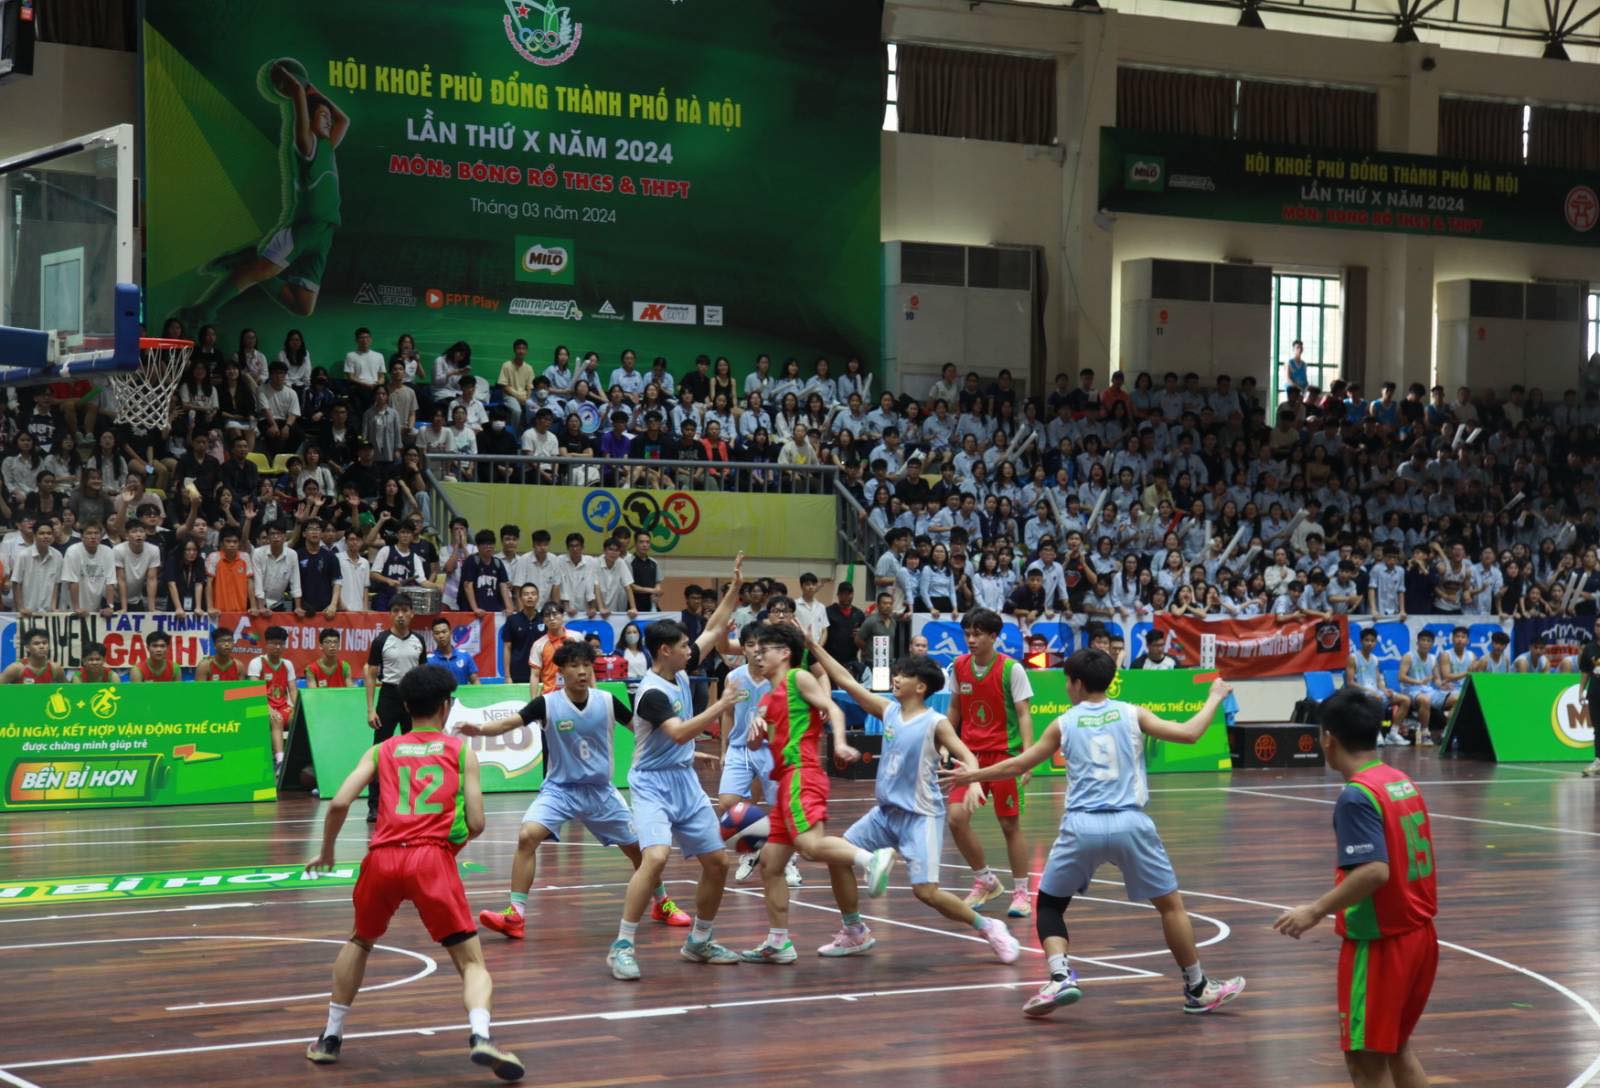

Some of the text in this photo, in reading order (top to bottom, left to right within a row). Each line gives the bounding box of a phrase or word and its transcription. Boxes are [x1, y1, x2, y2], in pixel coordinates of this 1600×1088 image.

[329, 57, 742, 133] HỘI KHOẺ PHÙ ĐỔNG THÀNH PHỐ HÀ NỘI
[407, 108, 674, 164] LẦN THỨ X NĂM 2024
[389, 153, 690, 199] MÔN: BÓNG RỔ THCS & THPT
[1245, 151, 1271, 177] HỘI
[1473, 171, 1492, 192] HÀ
[1495, 171, 1519, 196] NỘI
[470, 197, 616, 224] Tháng 03 năm 2024
[1371, 191, 1382, 206] X
[1387, 188, 1424, 209] NĂM
[1428, 197, 1465, 212] 2024
[529, 253, 563, 267] MILO
[446, 293, 499, 312] FPT Play
[511, 298, 543, 311] AMITA
[543, 300, 567, 313] PLUS
[905, 311, 915, 321] 10
[1156, 327, 1164, 337] 11
[103, 632, 197, 667] GAH
[23, 723, 60, 739] NGÀY,
[63, 722, 86, 737] KẾT
[89, 724, 116, 739] HỢP
[118, 722, 145, 739] VẬN
[145, 721, 183, 738] ĐỘNG
[185, 718, 208, 735] THỂ
[210, 719, 241, 735] CHẤT
[22, 739, 148, 753] được chứng minh giúp trẻ
[1089, 733, 1120, 781] 9
[21, 764, 138, 790] BỀN BỈ HƠN
[395, 764, 445, 815] 12
[1399, 811, 1434, 881] 15
